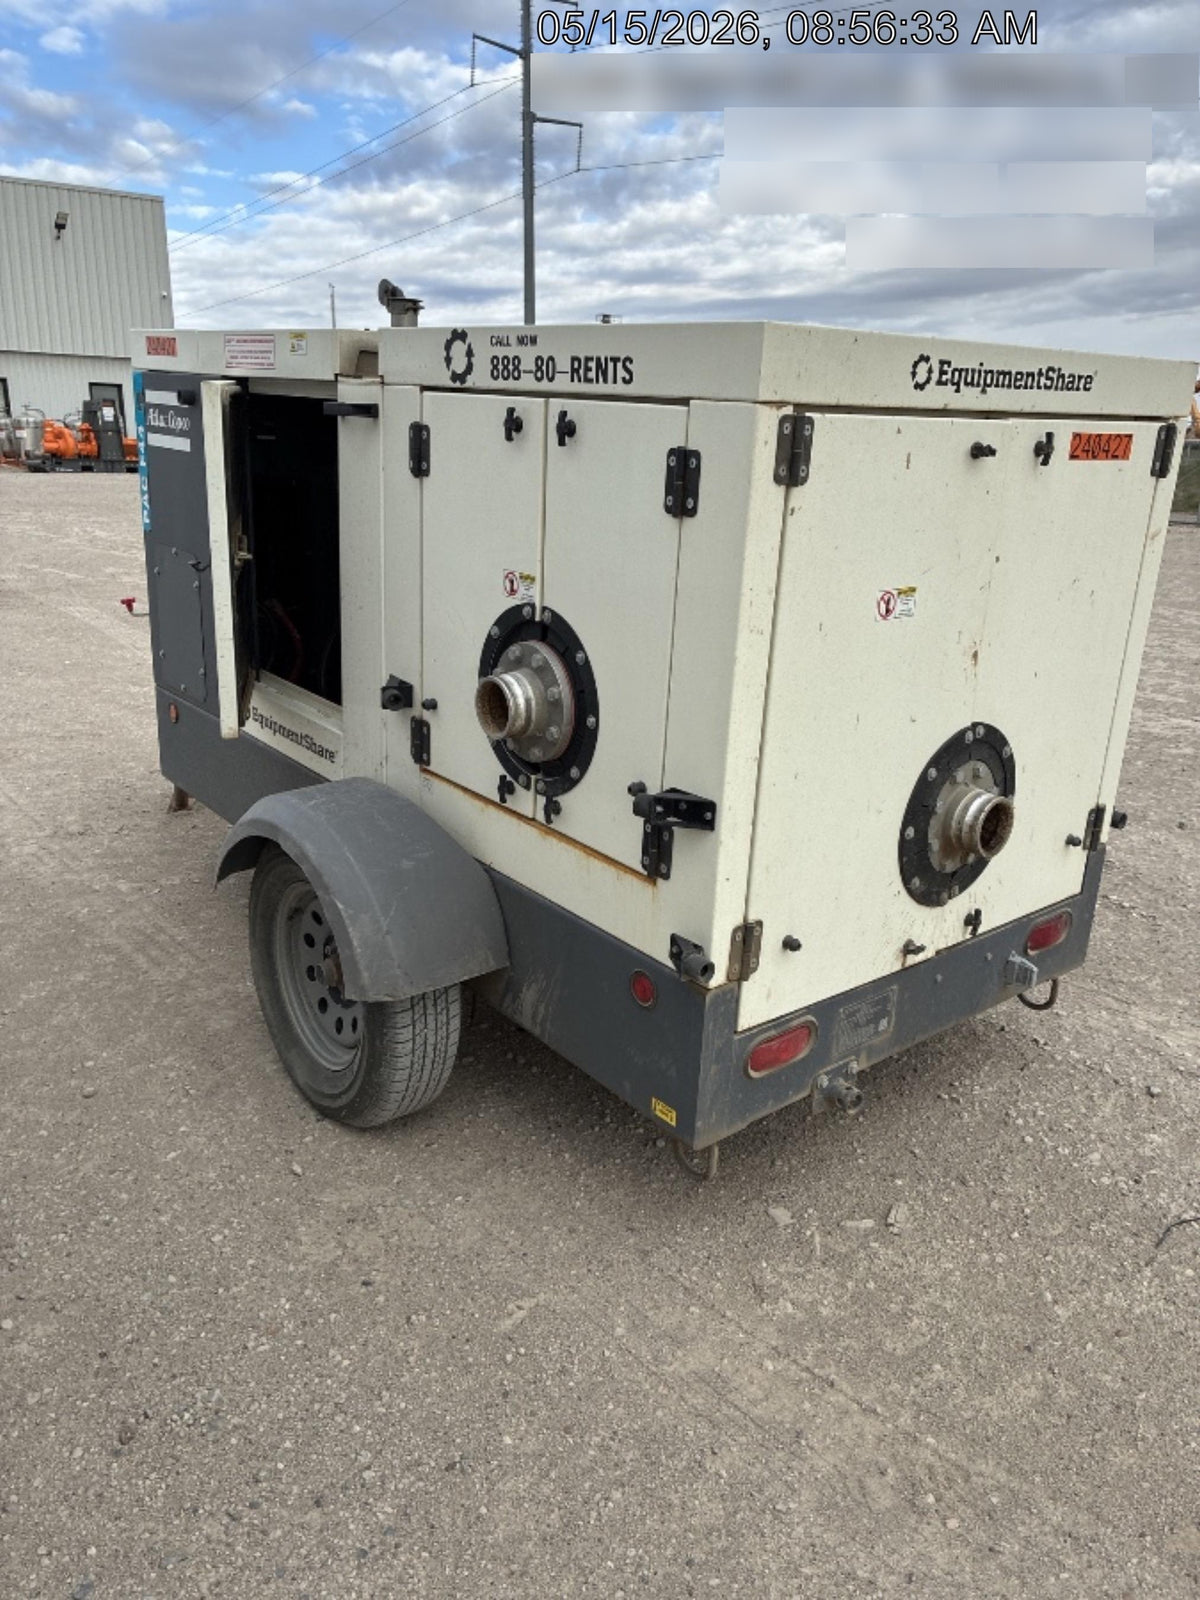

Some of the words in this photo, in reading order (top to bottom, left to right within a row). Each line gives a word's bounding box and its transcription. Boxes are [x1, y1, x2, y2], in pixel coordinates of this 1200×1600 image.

[490, 335, 512, 347] CALL
[516, 335, 538, 347] NOW
[490, 355, 634, 384] 888-80-RENTS
[935, 359, 1094, 394] EquipmentShare
[1069, 432, 1133, 461] 240427
[252, 706, 335, 763] EquipmentShare
